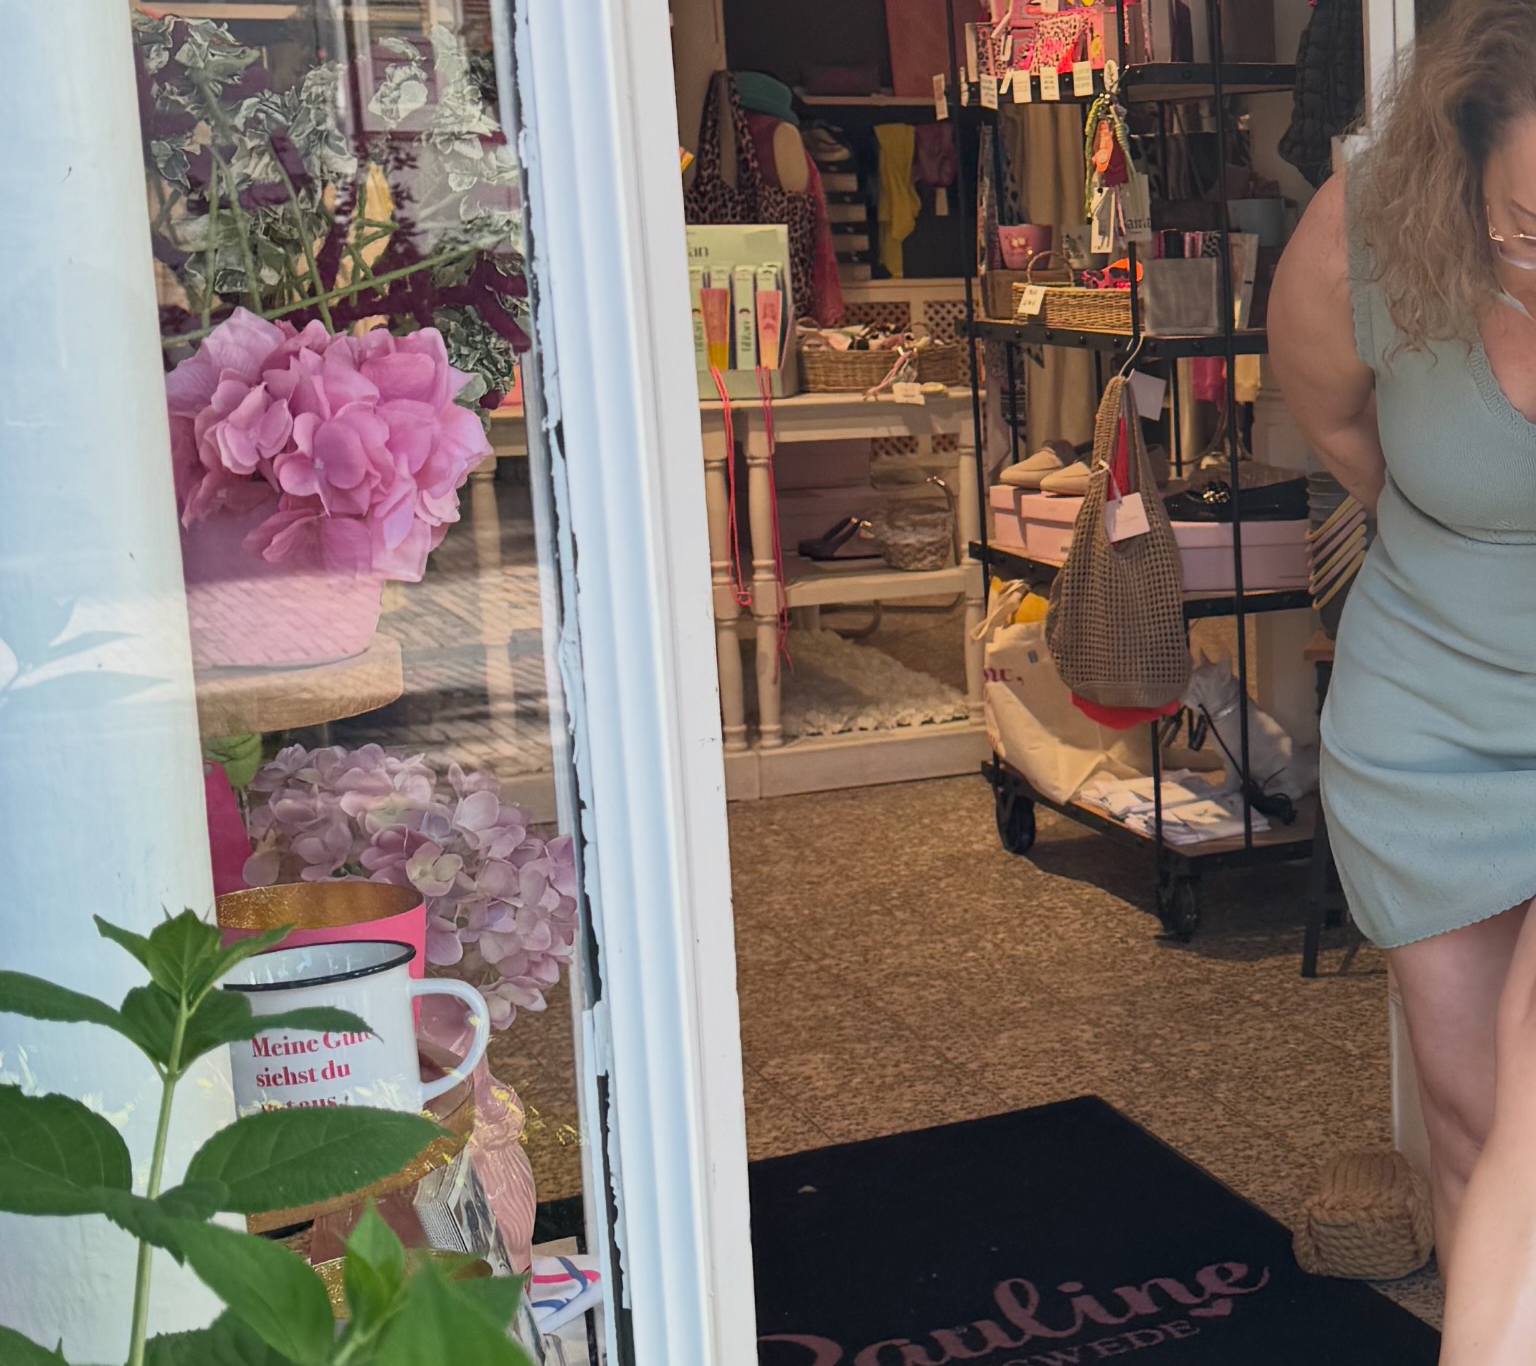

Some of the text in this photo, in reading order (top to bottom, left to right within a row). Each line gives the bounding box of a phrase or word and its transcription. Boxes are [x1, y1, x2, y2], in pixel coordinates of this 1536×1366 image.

[251, 1035, 319, 1057] Meine
[256, 1060, 350, 1088] siehst du
